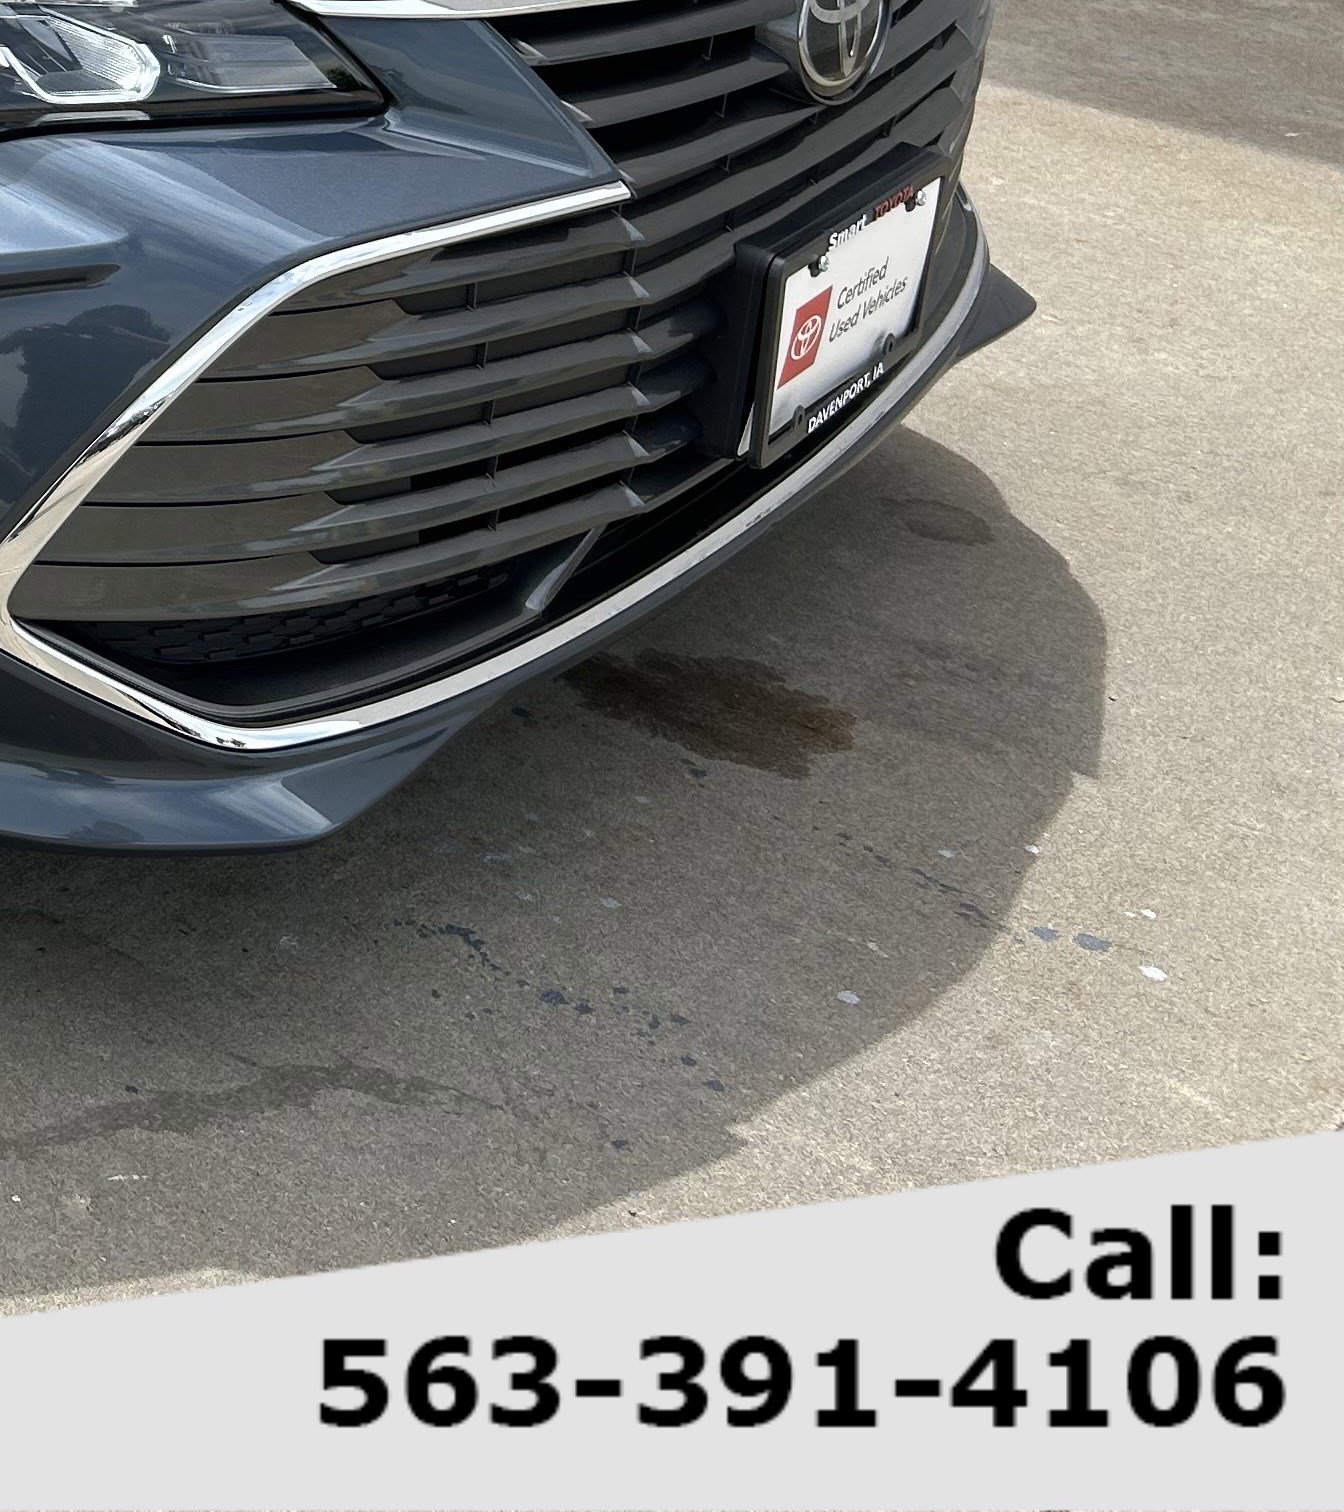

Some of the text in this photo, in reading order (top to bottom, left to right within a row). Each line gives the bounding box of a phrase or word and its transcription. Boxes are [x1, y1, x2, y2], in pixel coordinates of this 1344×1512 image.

[829, 213, 868, 249] Smart
[829, 276, 909, 343] Used Vehicles
[837, 256, 889, 310] Certified
[807, 361, 884, 434] DAVENPORT, IA
